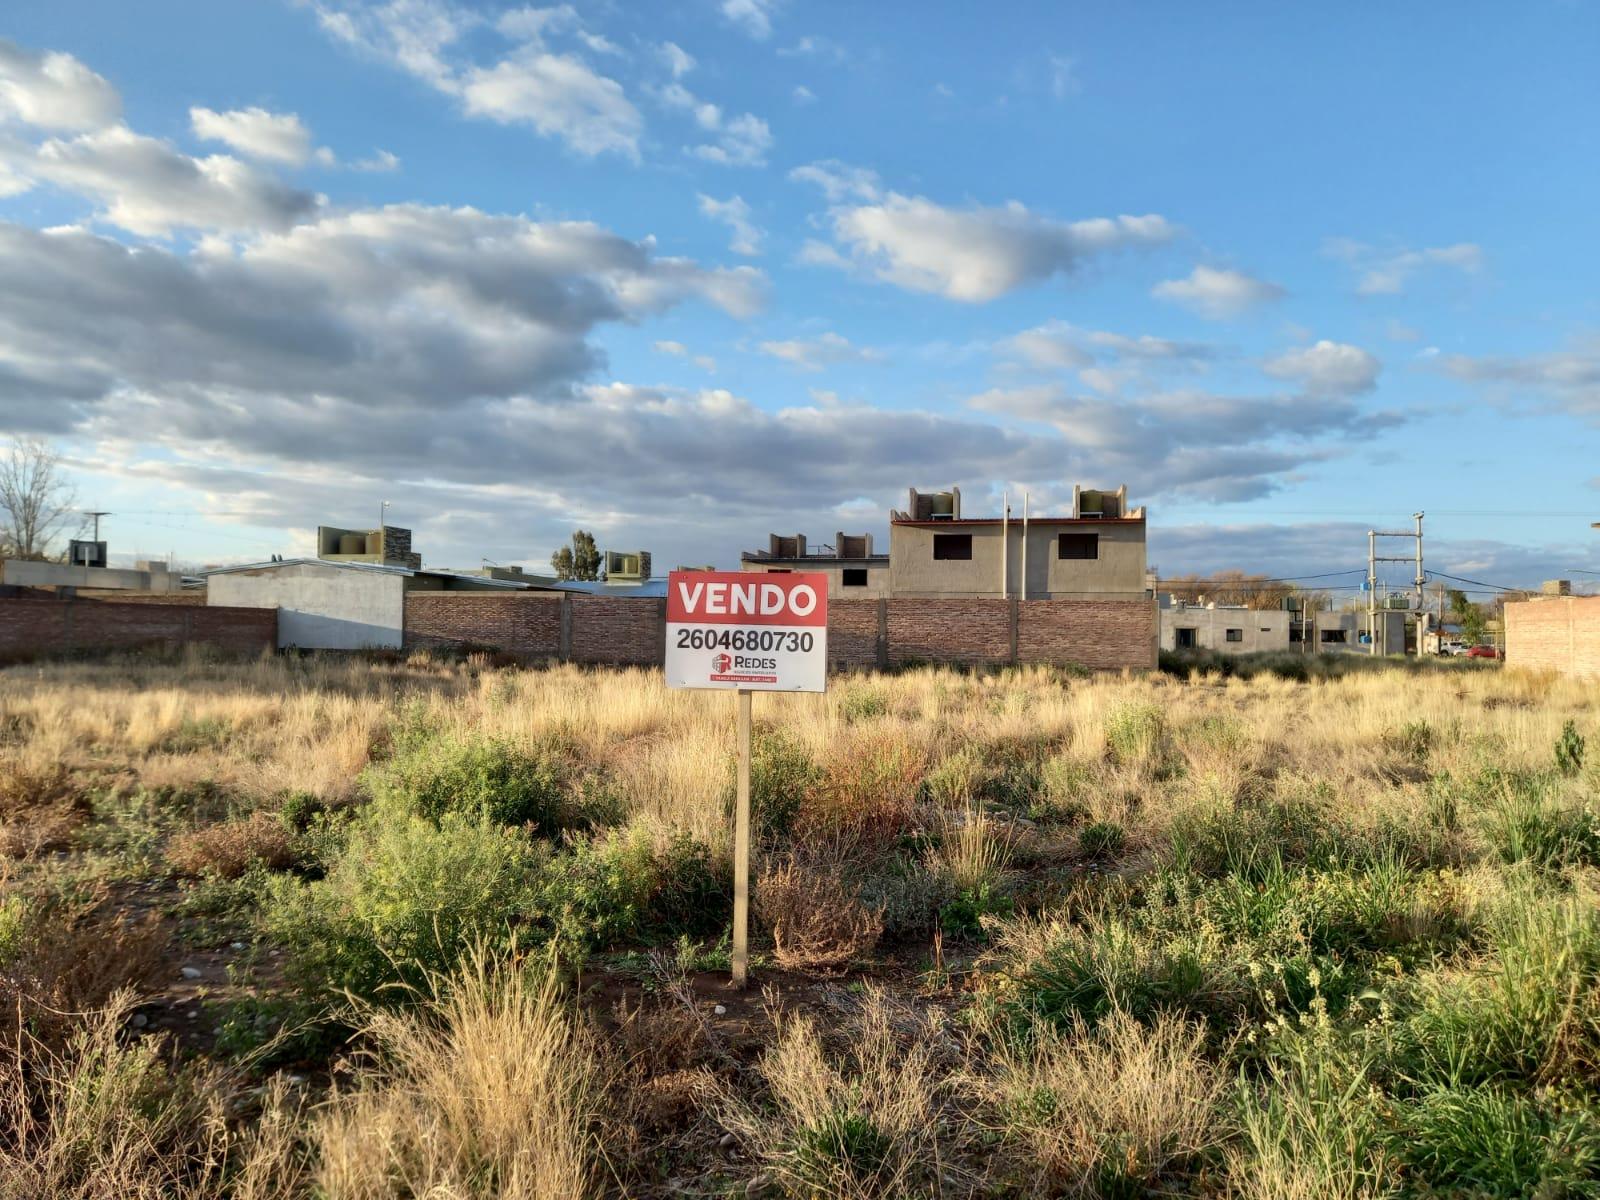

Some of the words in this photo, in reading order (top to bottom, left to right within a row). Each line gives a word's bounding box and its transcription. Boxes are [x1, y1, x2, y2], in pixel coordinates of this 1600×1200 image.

[678, 582, 817, 617] VENDO
[677, 628, 814, 653] 2604680730
[734, 655, 776, 669] REDES
